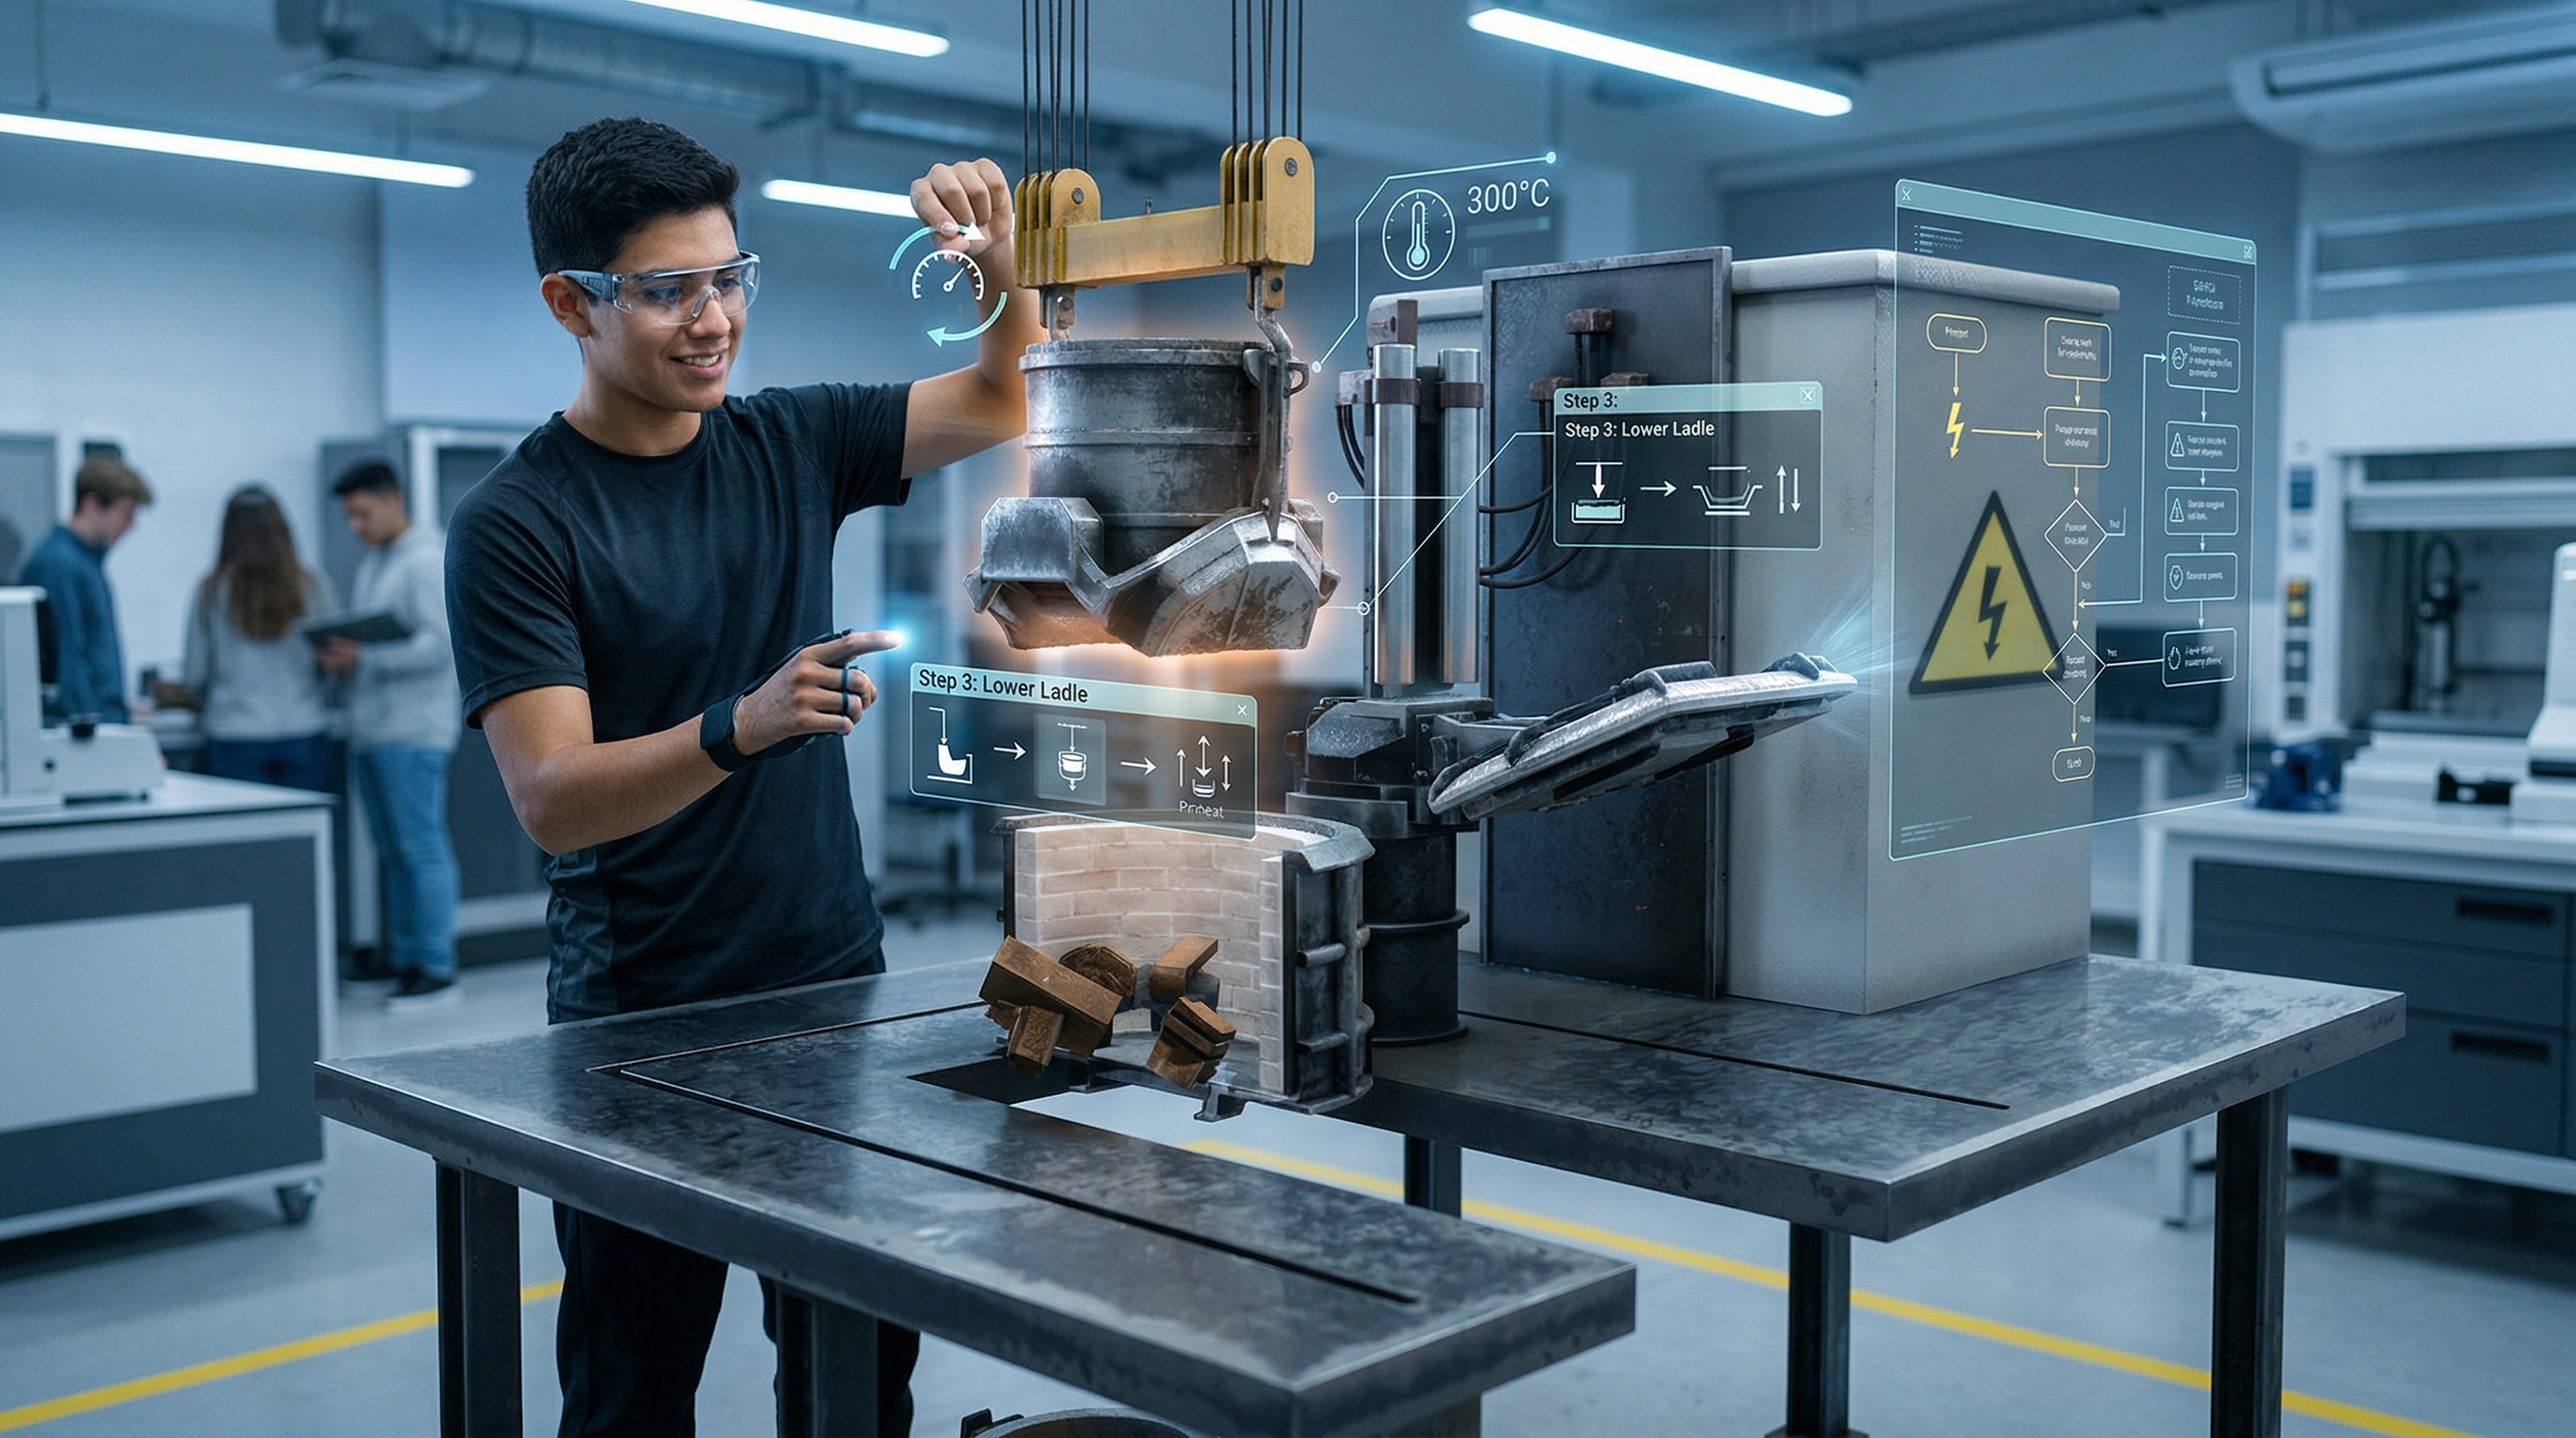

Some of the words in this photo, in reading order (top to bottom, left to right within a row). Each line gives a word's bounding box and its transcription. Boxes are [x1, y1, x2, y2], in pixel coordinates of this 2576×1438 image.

[1468, 179, 1550, 214] 300°C
[1564, 392, 1600, 412] Step
[1603, 391, 1618, 408] 3:
[1565, 422, 1600, 441] Step
[1603, 422, 1617, 437] 3:
[1622, 422, 1668, 437] Lower
[1673, 420, 1715, 437] Ladle
[918, 669, 957, 694] Step
[962, 673, 978, 692] 3:
[983, 675, 1035, 697] Lower
[1041, 681, 1088, 702] Ladle
